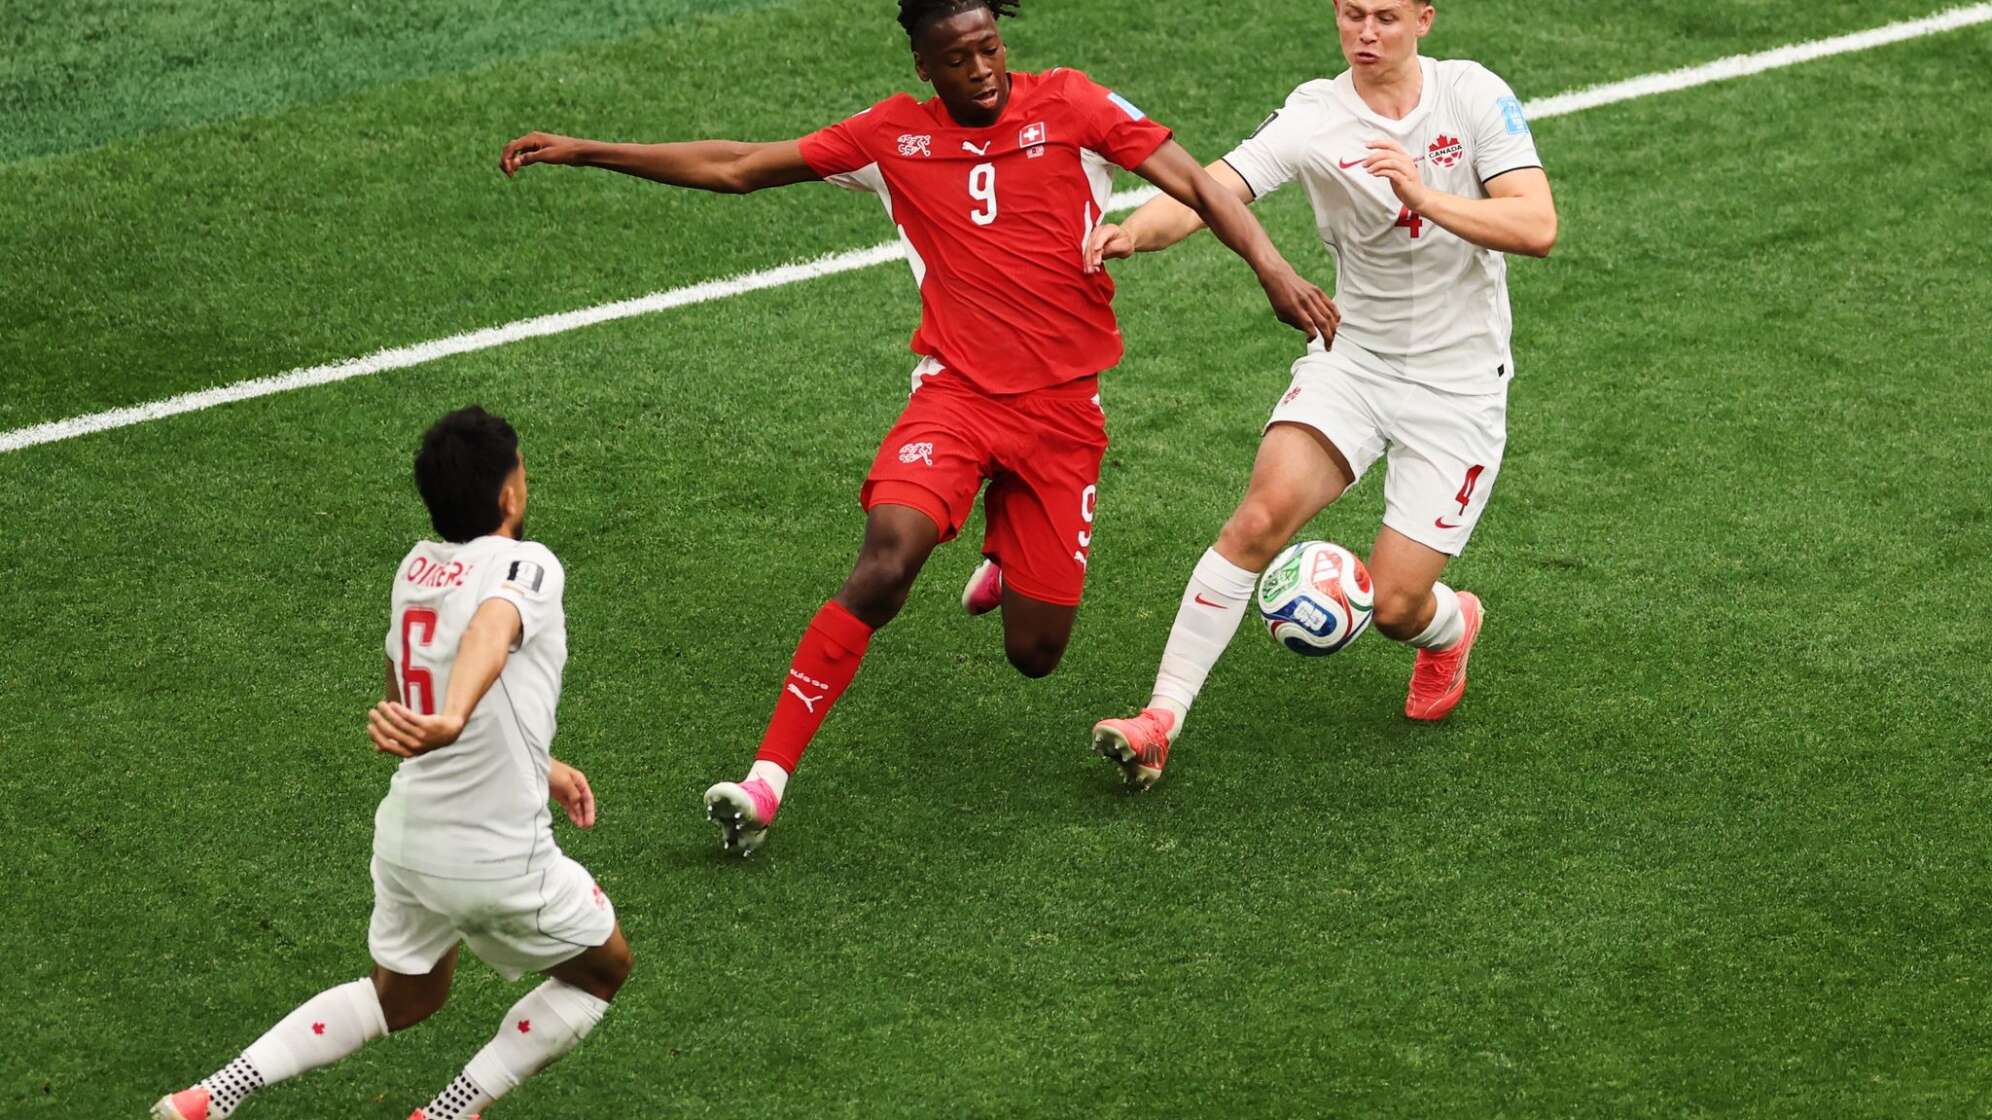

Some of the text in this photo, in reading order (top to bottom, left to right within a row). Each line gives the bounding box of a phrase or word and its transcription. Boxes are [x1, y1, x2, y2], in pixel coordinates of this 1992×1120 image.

[1428, 144, 1463, 159] CANADA
[968, 162, 998, 226] 9
[1395, 206, 1423, 239] 4
[1455, 464, 1485, 517] 4
[402, 607, 437, 716] 6
